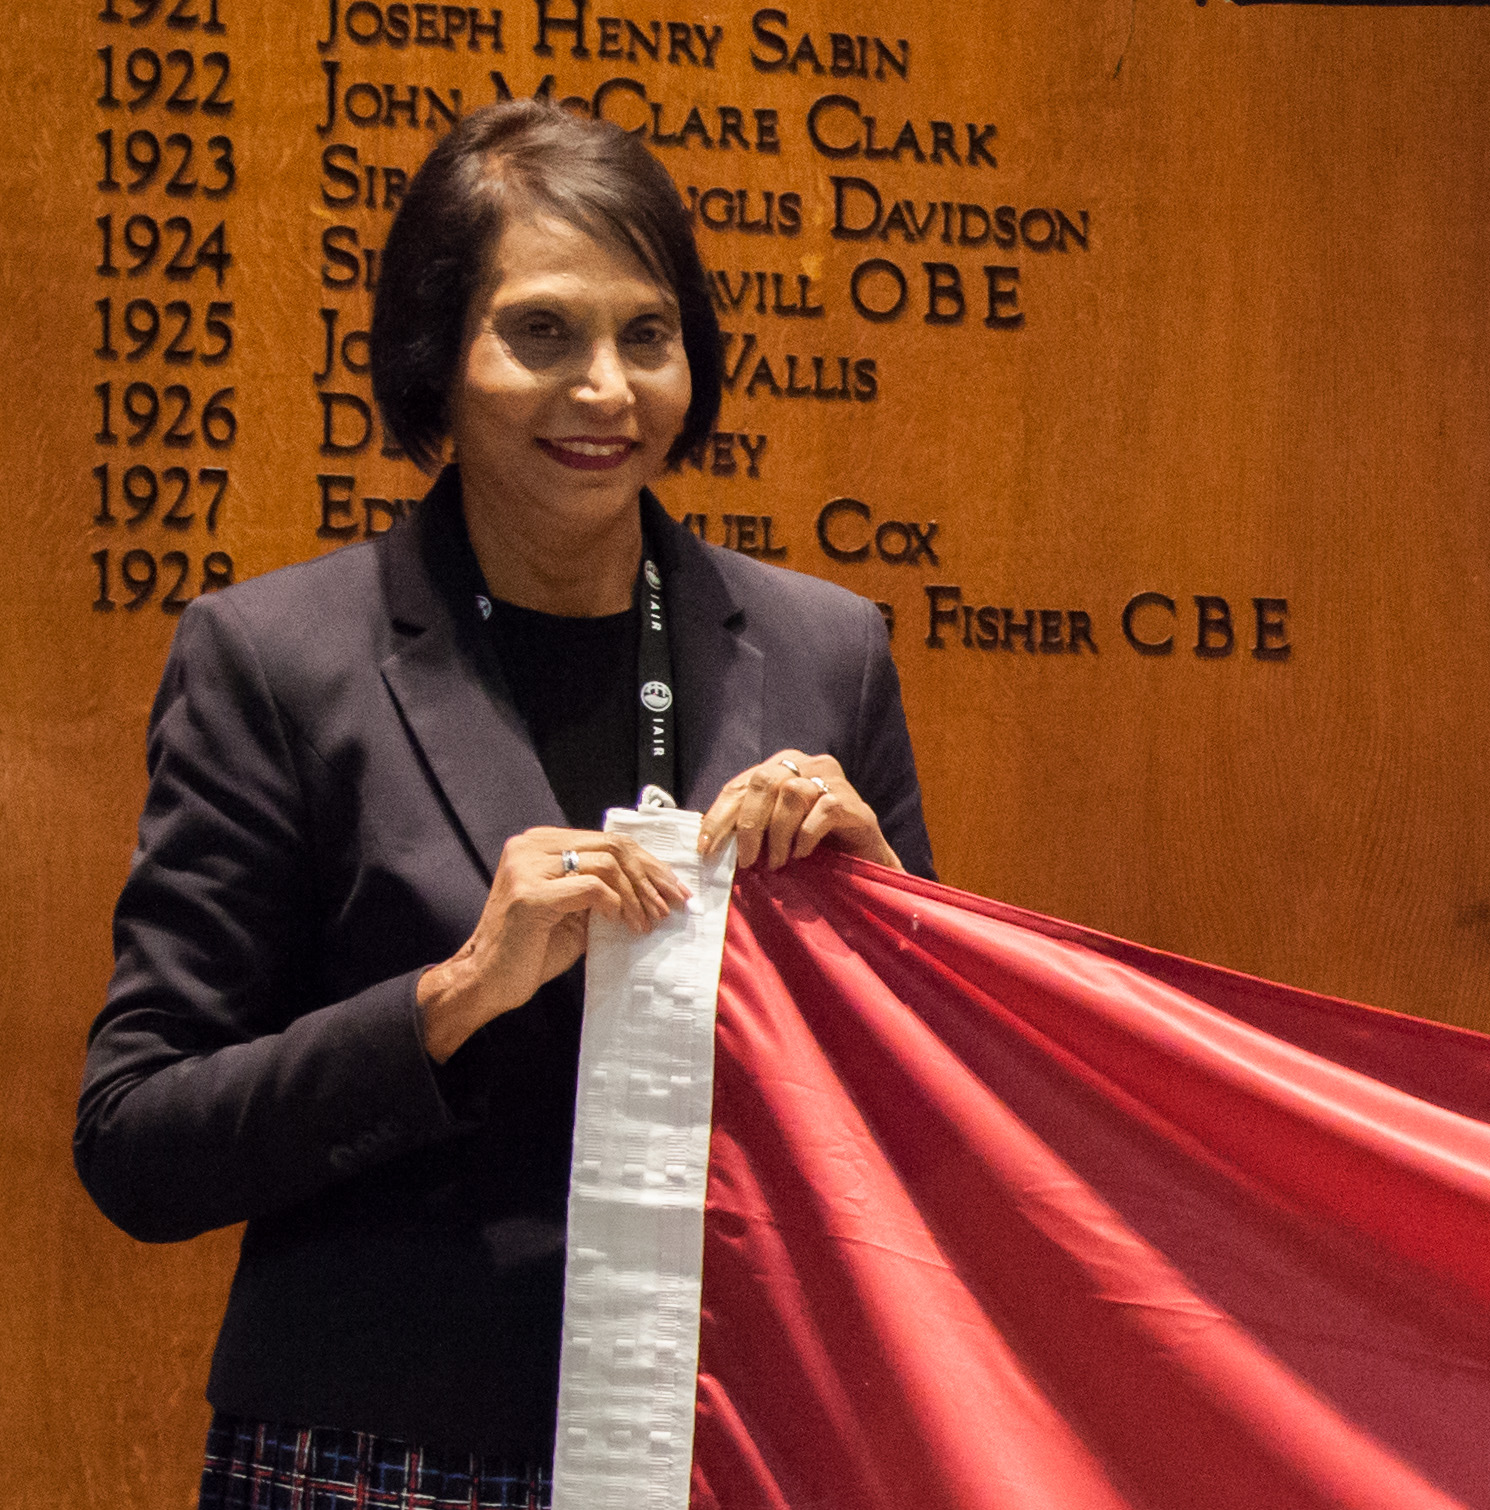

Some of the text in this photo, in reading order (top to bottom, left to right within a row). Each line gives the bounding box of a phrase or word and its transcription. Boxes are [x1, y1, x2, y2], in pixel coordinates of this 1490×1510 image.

[96, 45, 236, 119] 1922
[96, 128, 237, 196] 1923
[95, 214, 234, 285] 1924
[94, 297, 236, 365] 1925
[94, 381, 239, 449] 1926
[93, 463, 230, 532] 1927
[91, 548, 235, 614] 1928
[1120, 590, 1293, 661] CBE
[653, 717, 665, 757] IAIR
